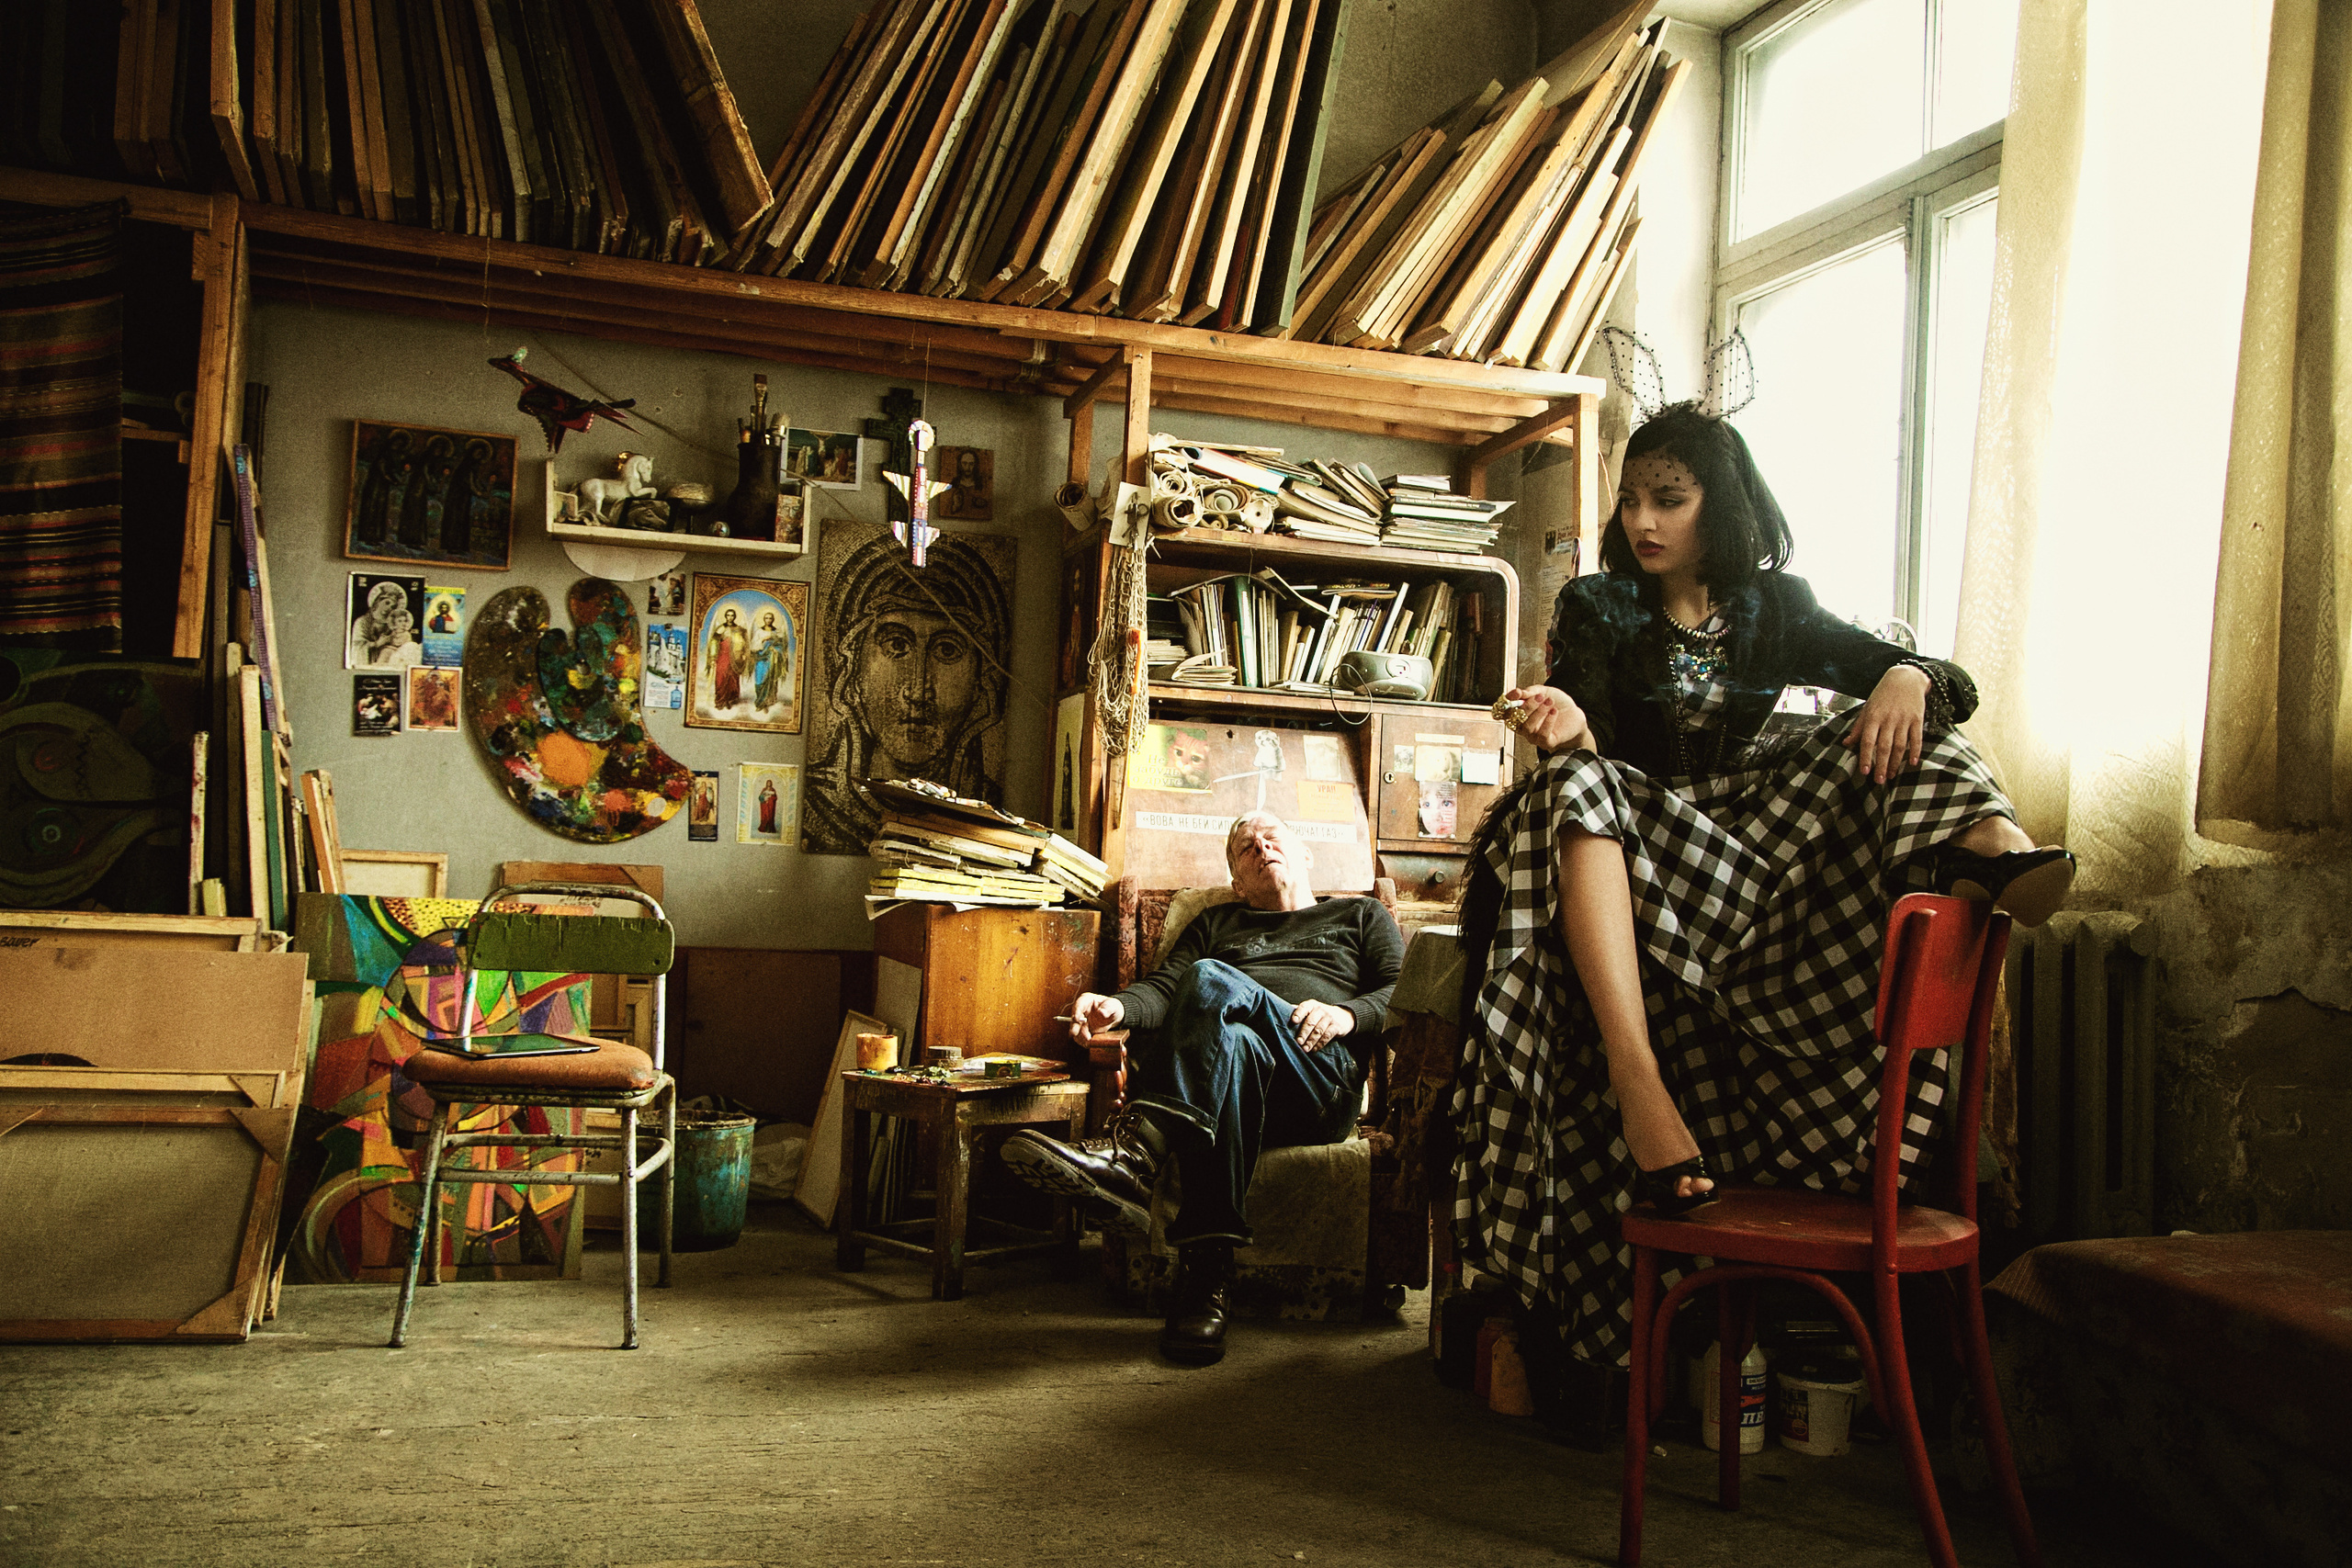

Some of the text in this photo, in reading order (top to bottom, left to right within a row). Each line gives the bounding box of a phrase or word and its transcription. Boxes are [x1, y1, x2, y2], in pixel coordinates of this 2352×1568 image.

[1148, 754, 1165, 764] Не
[1134, 764, 1180, 776] забудь
[1143, 776, 1183, 787] друге
[1179, 818, 1189, 828] НЕ
